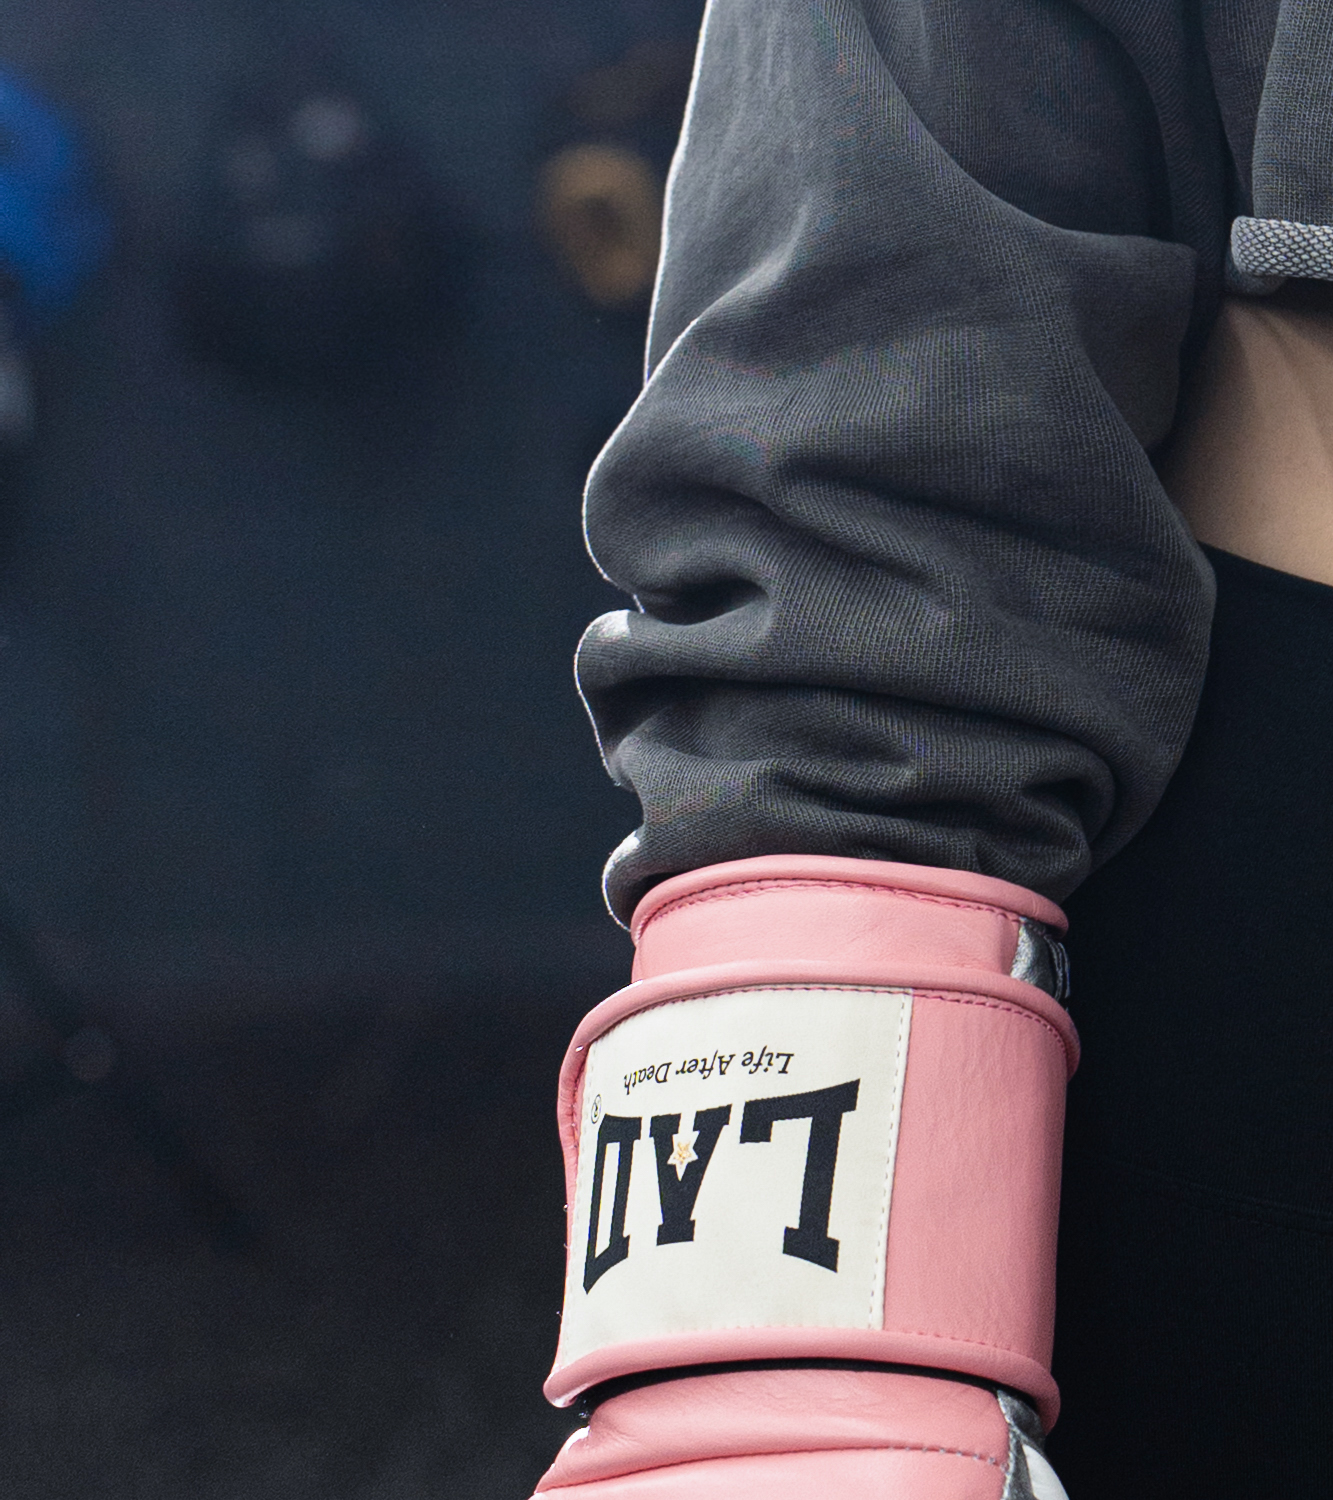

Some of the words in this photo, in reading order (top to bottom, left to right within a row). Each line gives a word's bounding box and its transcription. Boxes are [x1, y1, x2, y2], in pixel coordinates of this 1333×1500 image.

[675, 1049, 736, 1080] After
[740, 1045, 795, 1075] Life
[623, 1061, 673, 1096] Death
[582, 1078, 861, 1296] LAD
